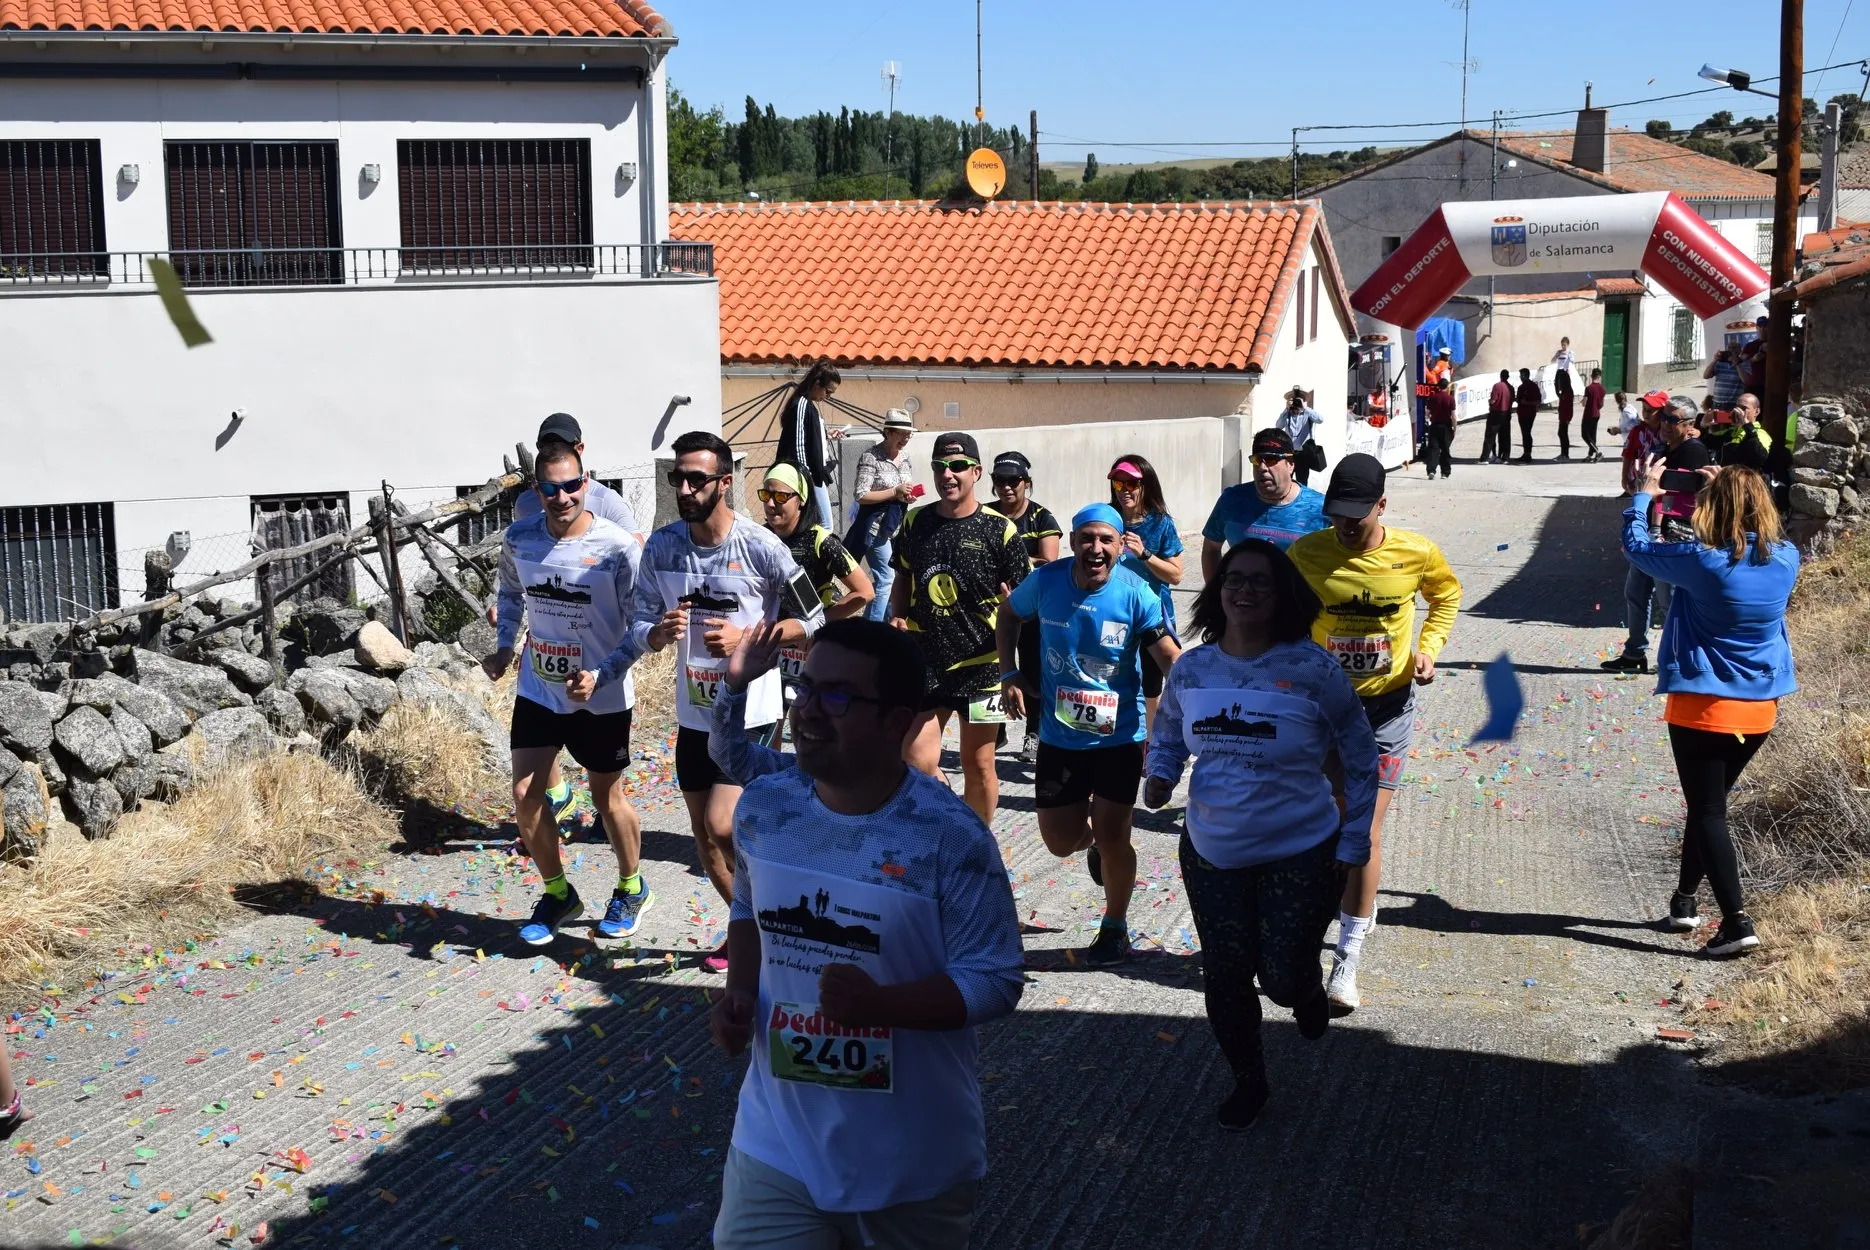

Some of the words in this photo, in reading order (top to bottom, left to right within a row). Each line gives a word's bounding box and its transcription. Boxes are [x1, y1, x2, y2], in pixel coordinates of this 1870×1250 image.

[1528, 219, 1600, 237] Diputación
[1529, 248, 1541, 258] de
[1546, 243, 1614, 257] Salamanca
[1663, 230, 1688, 252] CON
[1686, 249, 1744, 298] NUESTROS
[1369, 293, 1392, 315] CON
[1390, 281, 1406, 296] EL
[1404, 236, 1451, 282] DEPORTE
[1657, 244, 1726, 305] DEPORTISTAS
[1105, 634, 1120, 646] AXA
[1327, 639, 1391, 653] bedunia
[536, 653, 569, 674] 168
[1339, 652, 1379, 670] 287
[1057, 688, 1117, 708] bedunia
[1073, 705, 1097, 723] 78
[760, 918, 804, 934] MALPARTIDA
[771, 934, 780, 945] Si
[781, 936, 807, 953] luchas
[806, 944, 834, 959] puedes
[768, 956, 776, 965] si
[785, 956, 810, 974] luchas
[791, 1035, 867, 1072] 240
